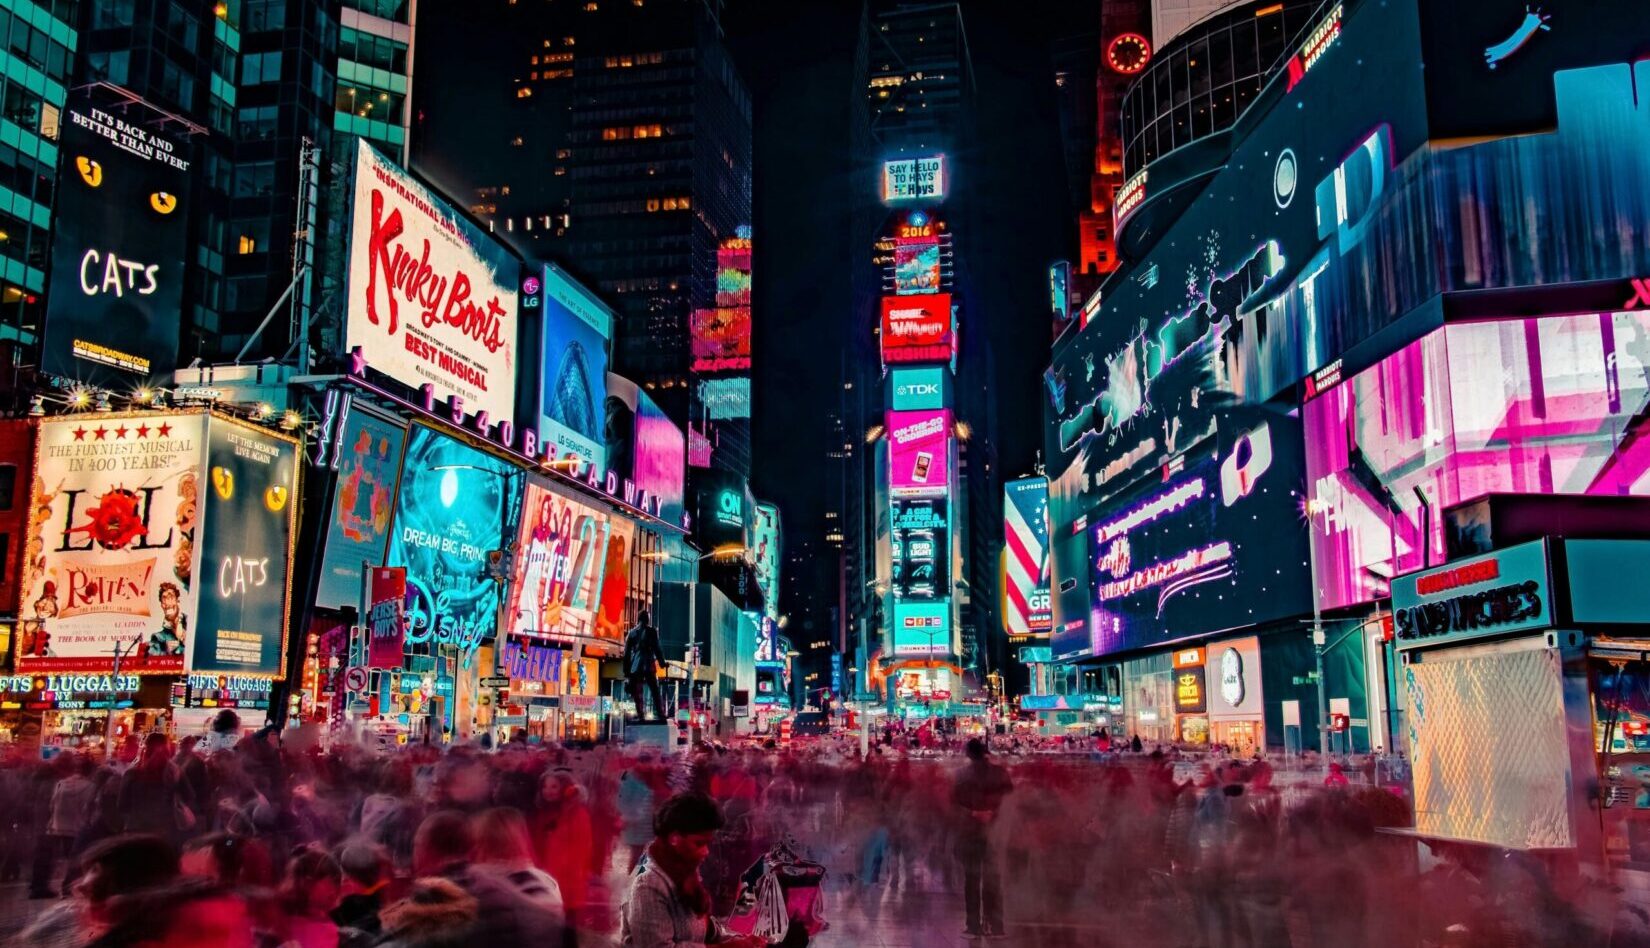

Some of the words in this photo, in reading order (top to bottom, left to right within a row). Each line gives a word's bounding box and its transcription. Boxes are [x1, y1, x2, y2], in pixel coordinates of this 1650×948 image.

[1303, 4, 1343, 57] MARRIOTT
[1304, 26, 1340, 72] MARQUIS
[91, 108, 114, 126] IT'S
[116, 119, 147, 141] BACK
[149, 136, 174, 153] AND
[120, 133, 153, 156] THAN
[889, 164, 907, 174] SAY
[910, 162, 939, 173] HELLO
[894, 174, 906, 183] TO
[909, 172, 934, 182] HAYS
[908, 184, 934, 195] Hays
[440, 216, 455, 236] AND
[902, 226, 930, 238] 2016
[81, 249, 159, 302] CATS
[366, 188, 446, 336] Kinky
[443, 270, 507, 354] Boots
[523, 297, 538, 307] LG
[405, 332, 437, 364] BEST
[438, 350, 488, 392] MUSICAL
[884, 345, 950, 361] TOSHIBA
[906, 384, 940, 395] TDK
[49, 445, 73, 457] THE
[76, 442, 134, 456] FUNNIEST
[138, 439, 192, 454] MUSICAL
[227, 432, 237, 445] LET
[238, 436, 253, 449] THE
[254, 440, 280, 458] MEMORY
[235, 444, 250, 459] LIVE
[419, 383, 510, 448] 1540
[522, 428, 662, 517] BROADWAY
[68, 458, 84, 472] IN
[88, 456, 116, 471] 400
[720, 492, 740, 515] ON
[403, 527, 440, 550] DREAM
[219, 556, 268, 600] CATS
[374, 617, 398, 638] BOYS
[58, 635, 74, 643] THE
[48, 675, 139, 692] LUGGAGE
[188, 677, 218, 690] GIFTS
[227, 677, 273, 692] LUGGAGE
[58, 701, 85, 709] SONY
